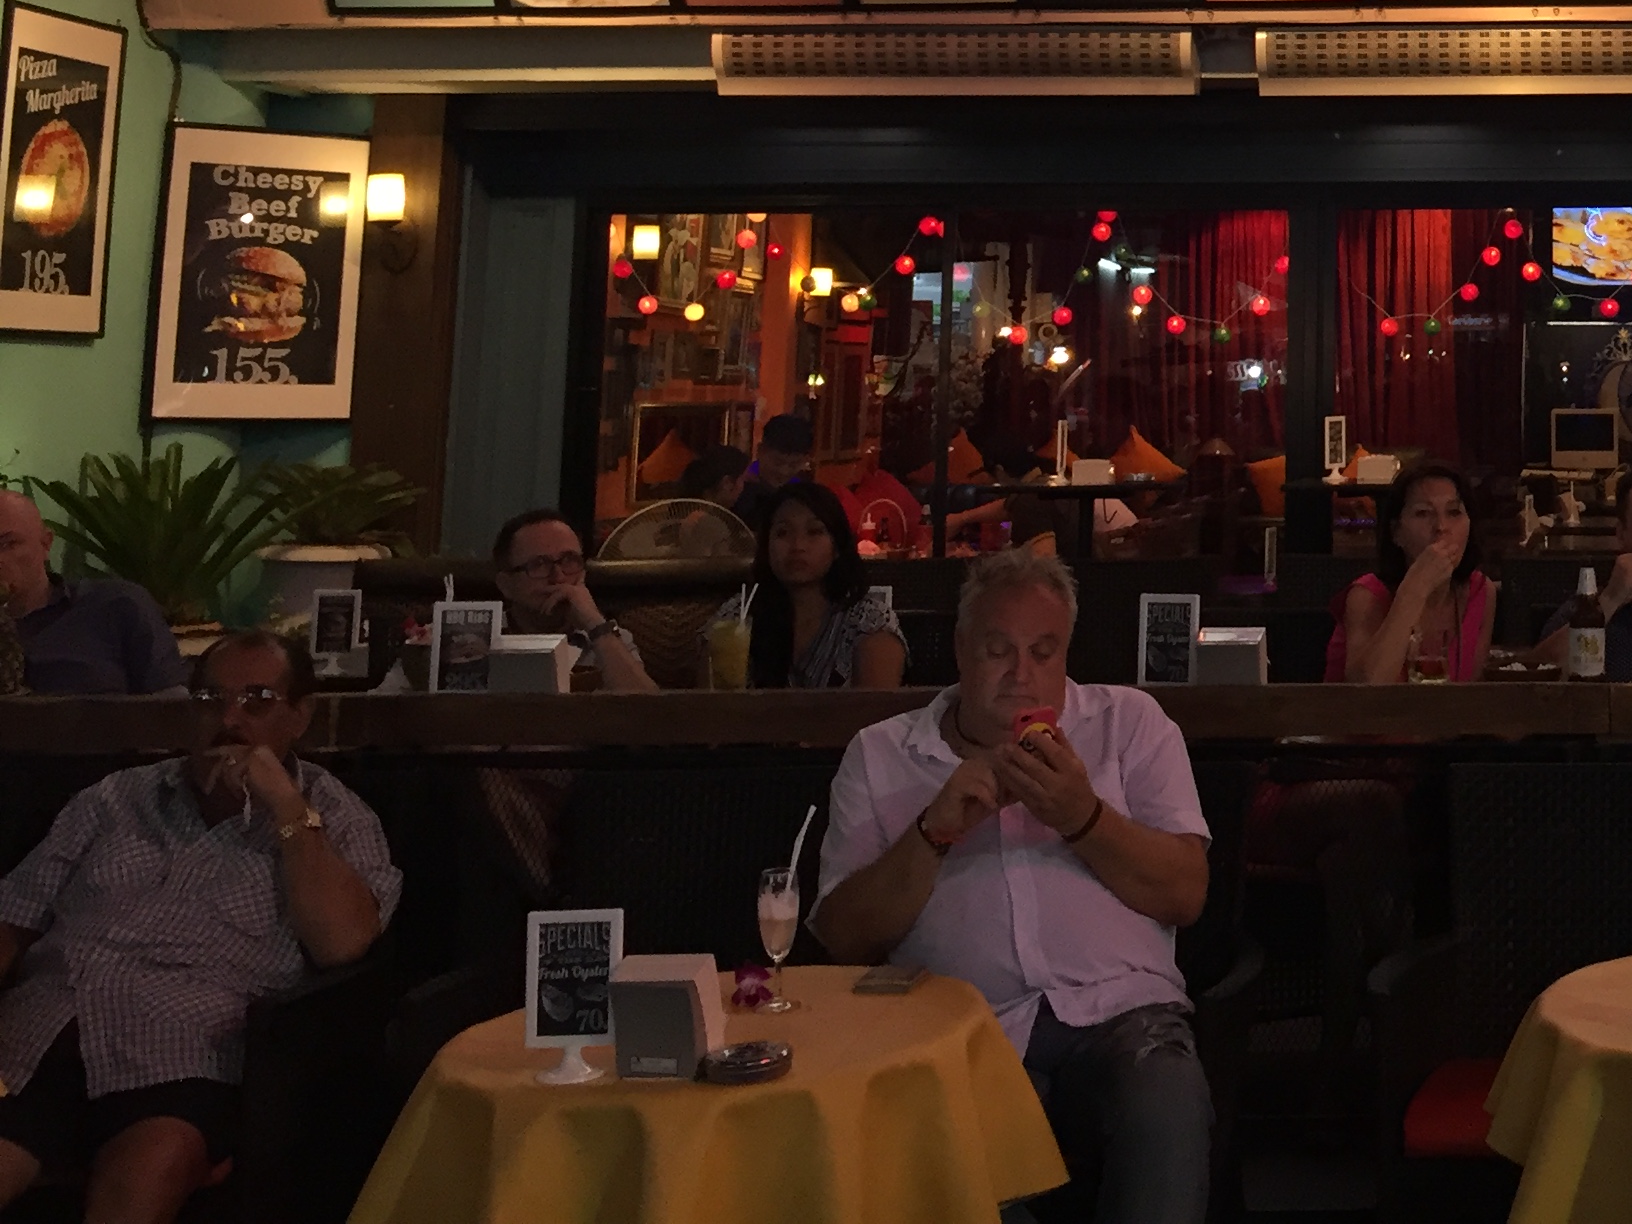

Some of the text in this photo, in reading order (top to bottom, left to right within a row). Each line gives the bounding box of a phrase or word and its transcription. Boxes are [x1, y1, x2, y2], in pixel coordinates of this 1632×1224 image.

[18, 55, 57, 82] Pizza
[26, 80, 98, 114] Margherita
[212, 164, 325, 198] Cheesy
[227, 191, 302, 218] Beef
[206, 218, 320, 246] Burger
[539, 922, 611, 958] SPECIALS
